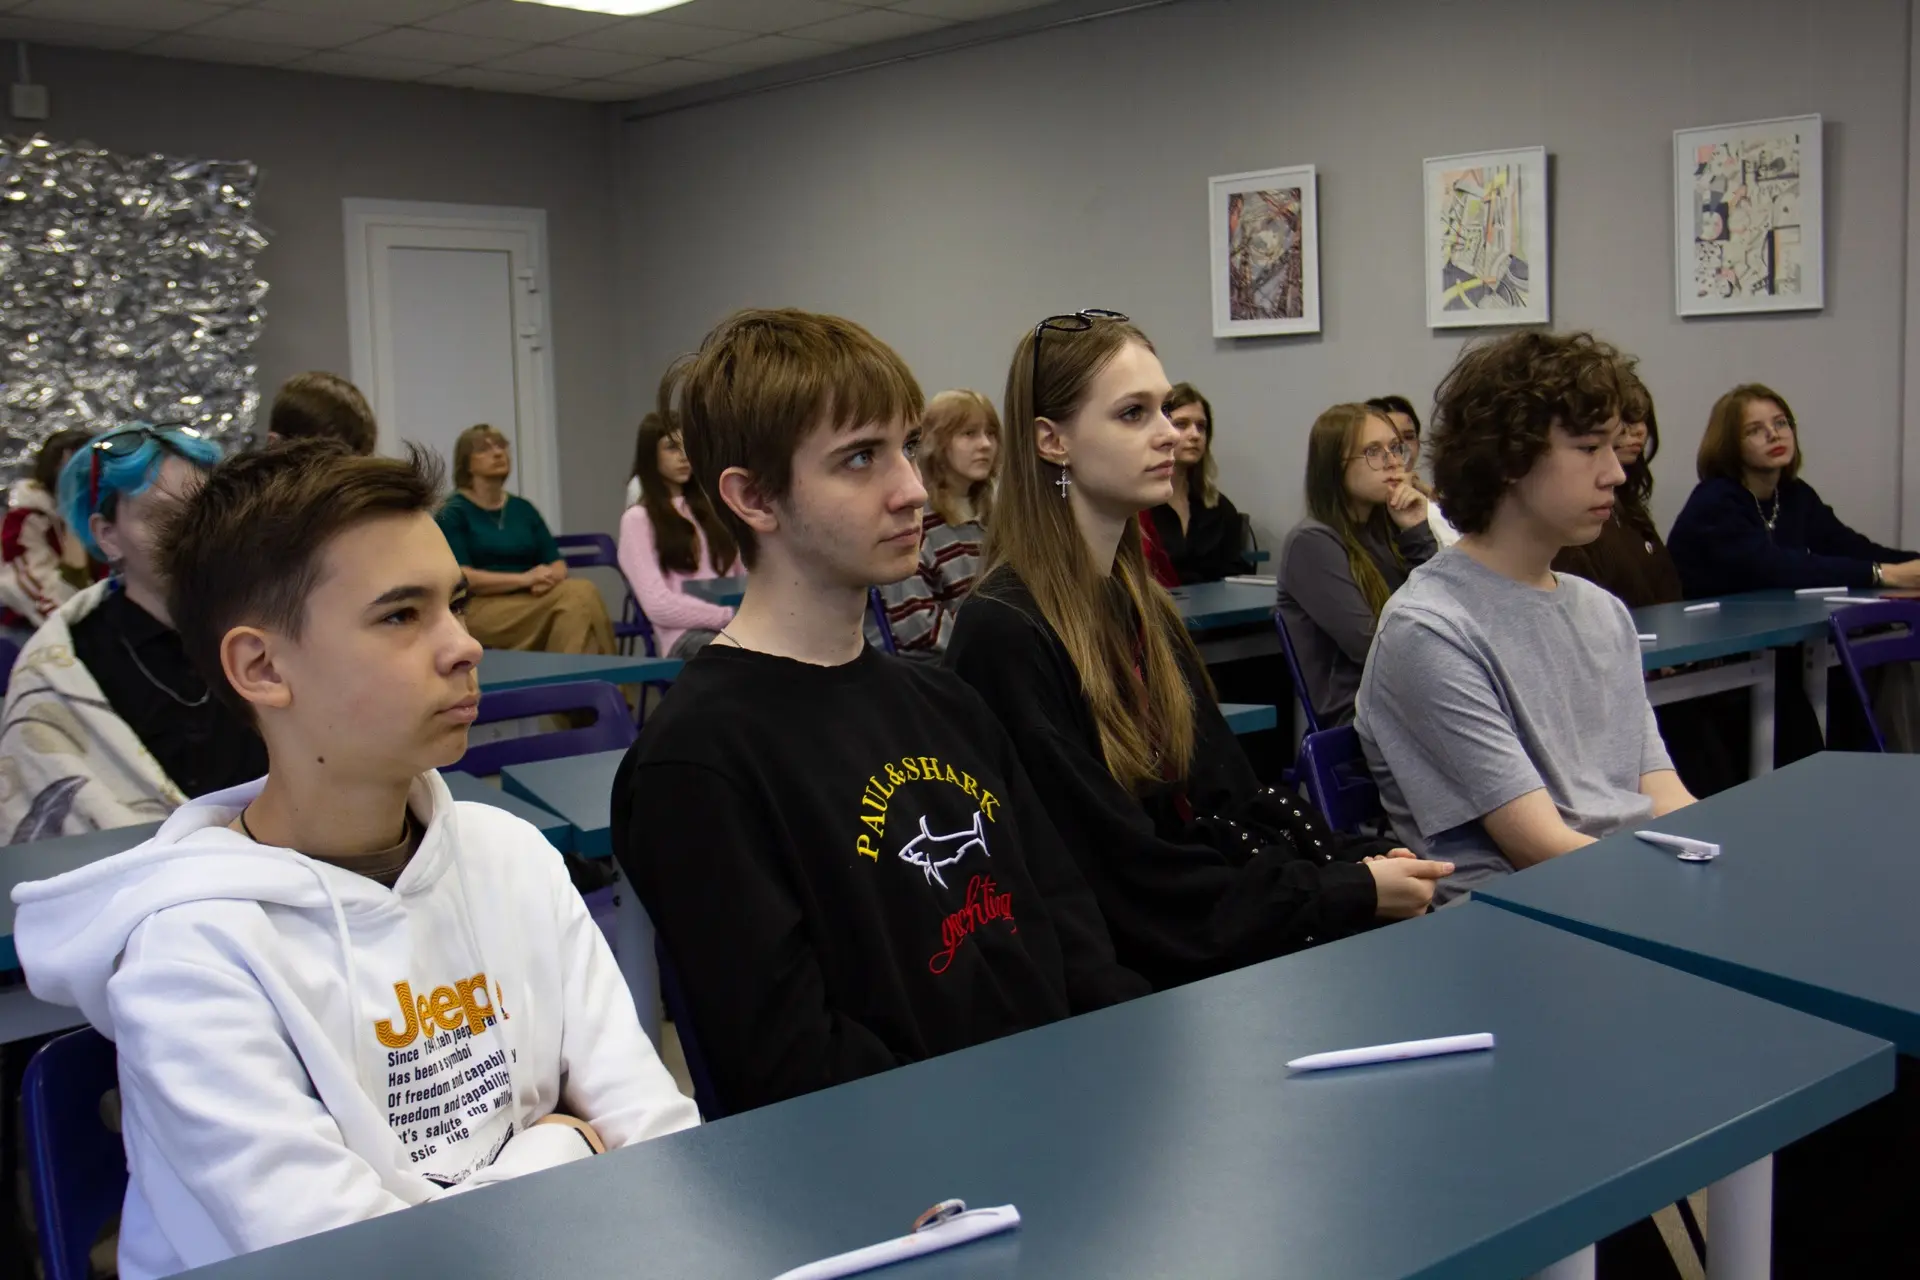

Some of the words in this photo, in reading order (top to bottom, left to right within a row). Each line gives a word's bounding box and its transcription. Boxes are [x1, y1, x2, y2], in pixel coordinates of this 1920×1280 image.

[374, 972, 495, 1048] Jeep
[388, 1049, 419, 1067] Since
[388, 1072, 411, 1087] Has
[415, 1066, 439, 1081] been
[388, 1091, 402, 1108] Of
[405, 1081, 451, 1104] freedom
[451, 1070, 464, 1089] and
[388, 1105, 440, 1127] Freedom
[443, 1094, 460, 1114] and
[425, 1117, 462, 1138] salute
[467, 1103, 488, 1117] the
